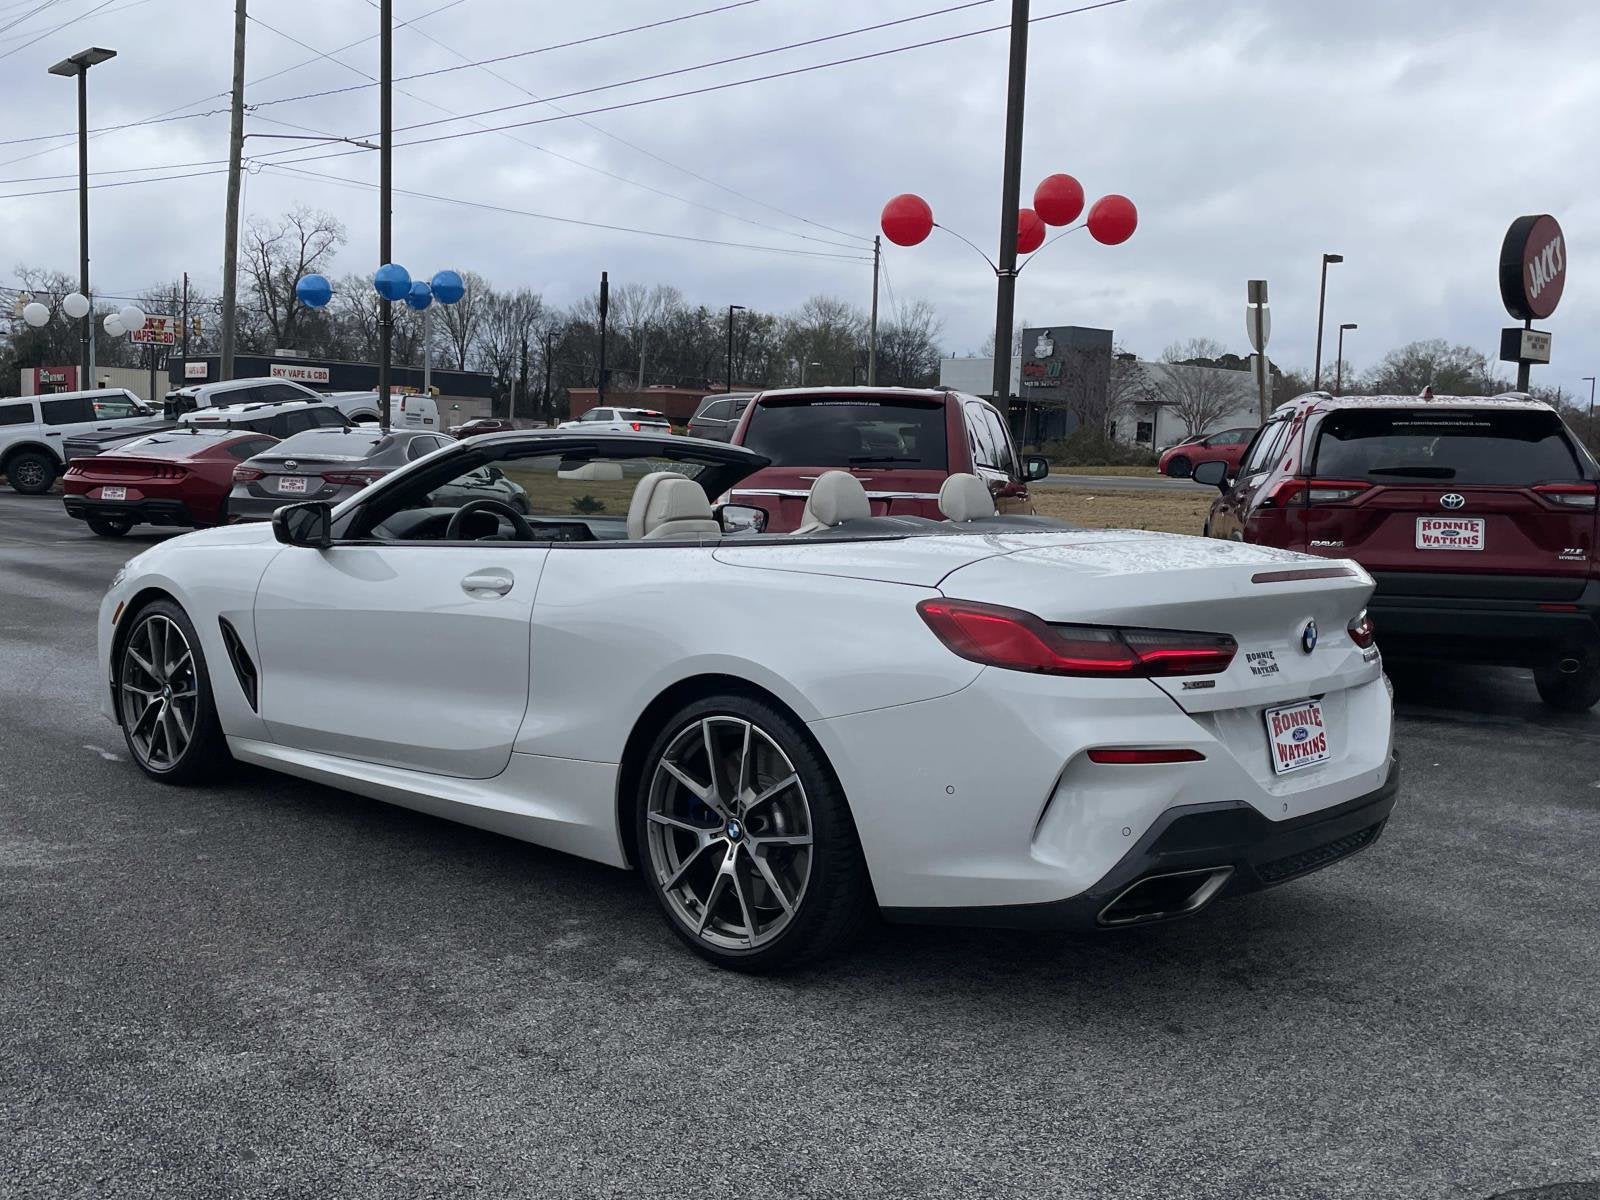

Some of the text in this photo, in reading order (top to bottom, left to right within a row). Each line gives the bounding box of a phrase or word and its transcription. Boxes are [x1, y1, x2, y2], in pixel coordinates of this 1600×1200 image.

[133, 329, 153, 342] VAPE
[272, 368, 328, 380] SKY VAPE & CBD
[1422, 521, 1479, 533] RONNIE
[1422, 534, 1479, 545] WATKINS
[1245, 651, 1275, 663] RONNIE
[1250, 663, 1280, 675] WATKINS
[1271, 707, 1323, 738] RONNIE
[1276, 731, 1327, 763] WATKINS
